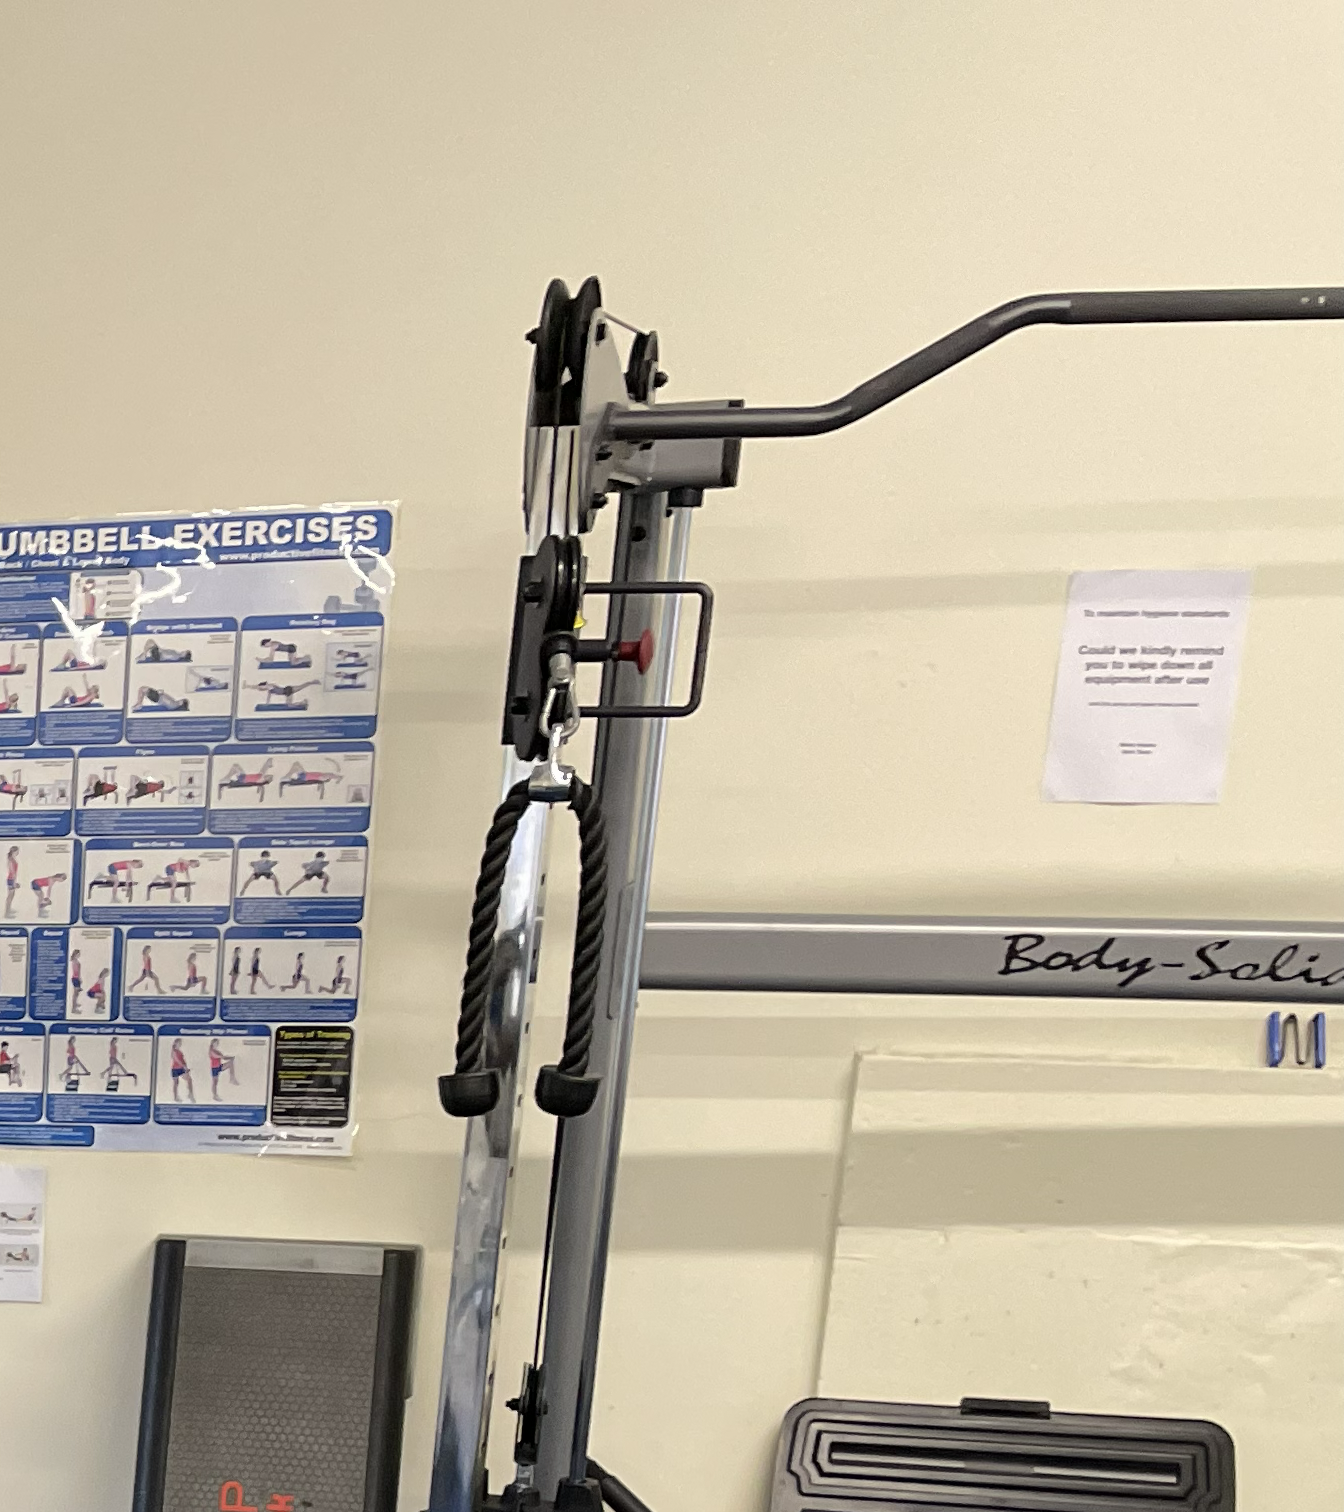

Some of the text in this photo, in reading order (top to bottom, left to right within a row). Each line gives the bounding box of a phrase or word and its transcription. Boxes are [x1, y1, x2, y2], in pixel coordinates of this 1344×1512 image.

[173, 514, 379, 549] EXERCISES
[1078, 645, 1225, 657] Could we kindly remind
[1084, 660, 1214, 672] you to wipe down all
[1084, 674, 1210, 685] equipment after use
